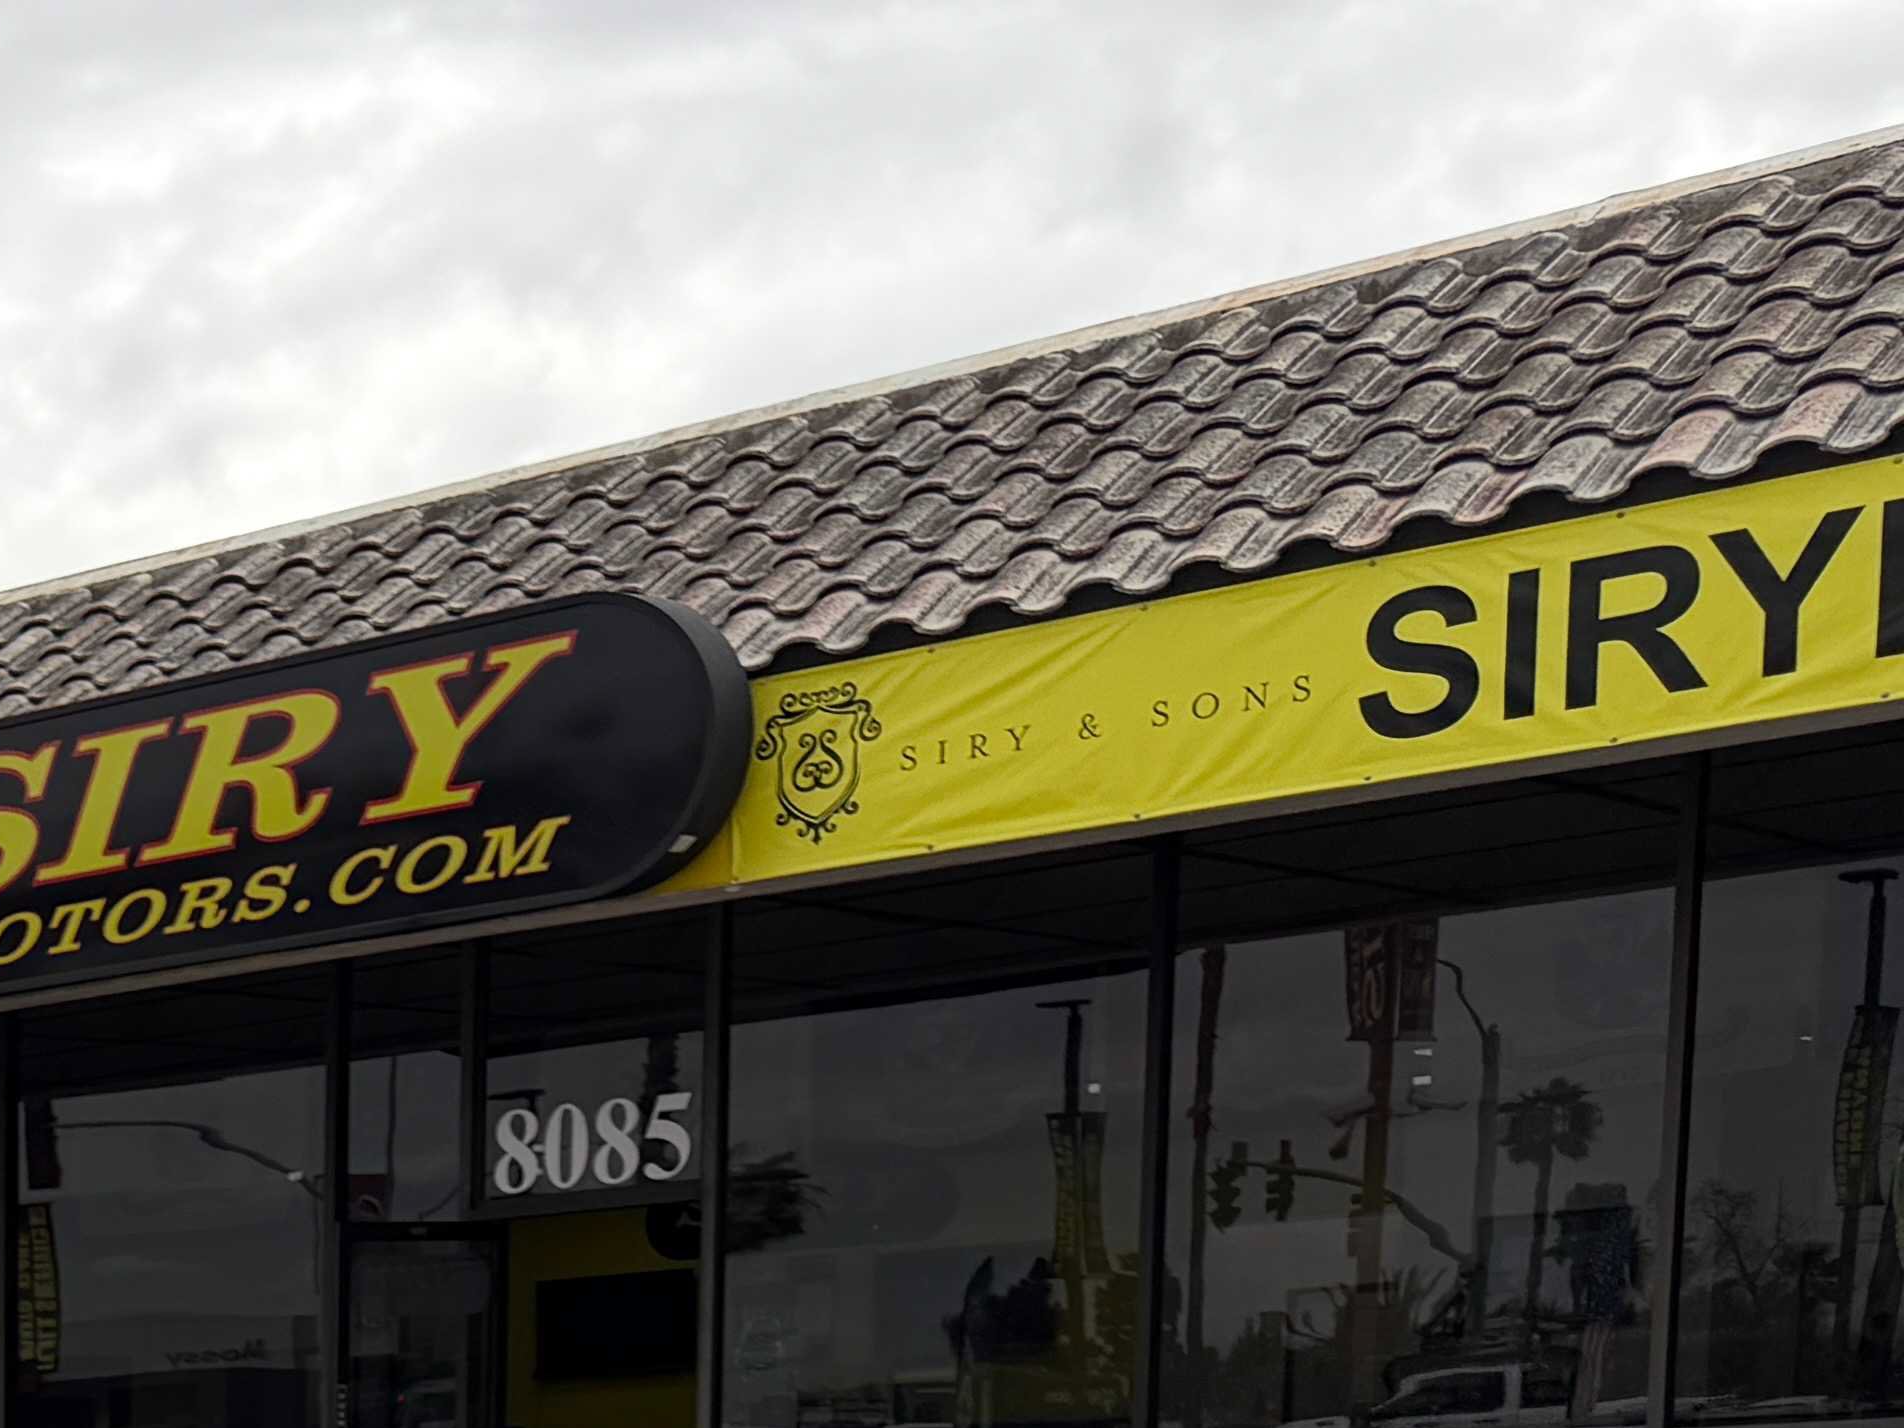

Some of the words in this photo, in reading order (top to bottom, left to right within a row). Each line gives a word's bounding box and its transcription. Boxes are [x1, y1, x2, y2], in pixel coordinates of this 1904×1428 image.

[899, 722, 1032, 772] SIRY
[1077, 713, 1103, 742] &
[1151, 674, 1315, 730] SONS
[494, 1092, 692, 1194] 8085
